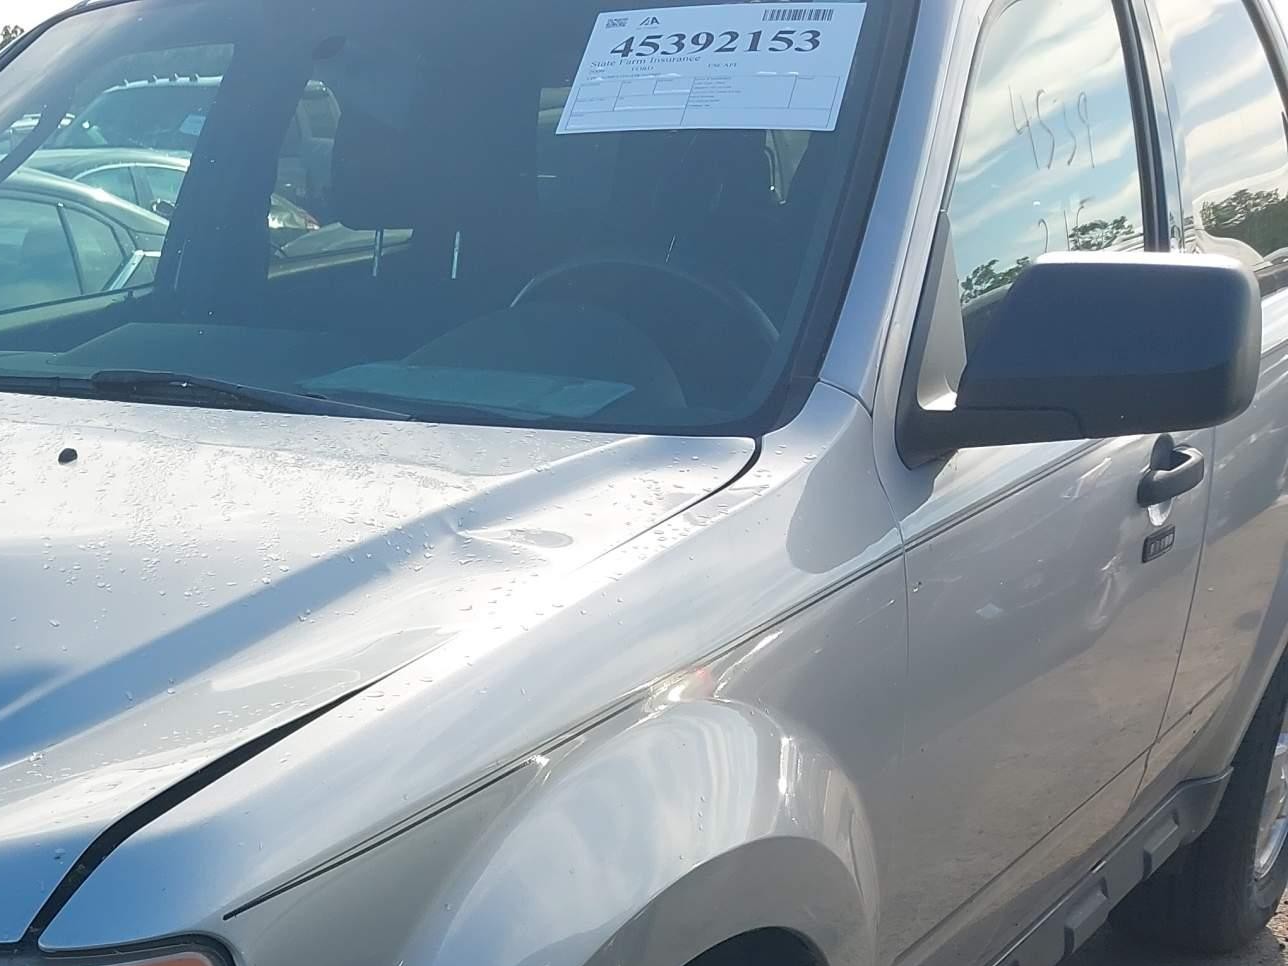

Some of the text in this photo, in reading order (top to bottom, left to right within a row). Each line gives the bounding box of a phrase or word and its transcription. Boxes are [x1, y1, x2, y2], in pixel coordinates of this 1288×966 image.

[610, 29, 822, 58] 45392153
[590, 55, 702, 69] State Farm Insurance
